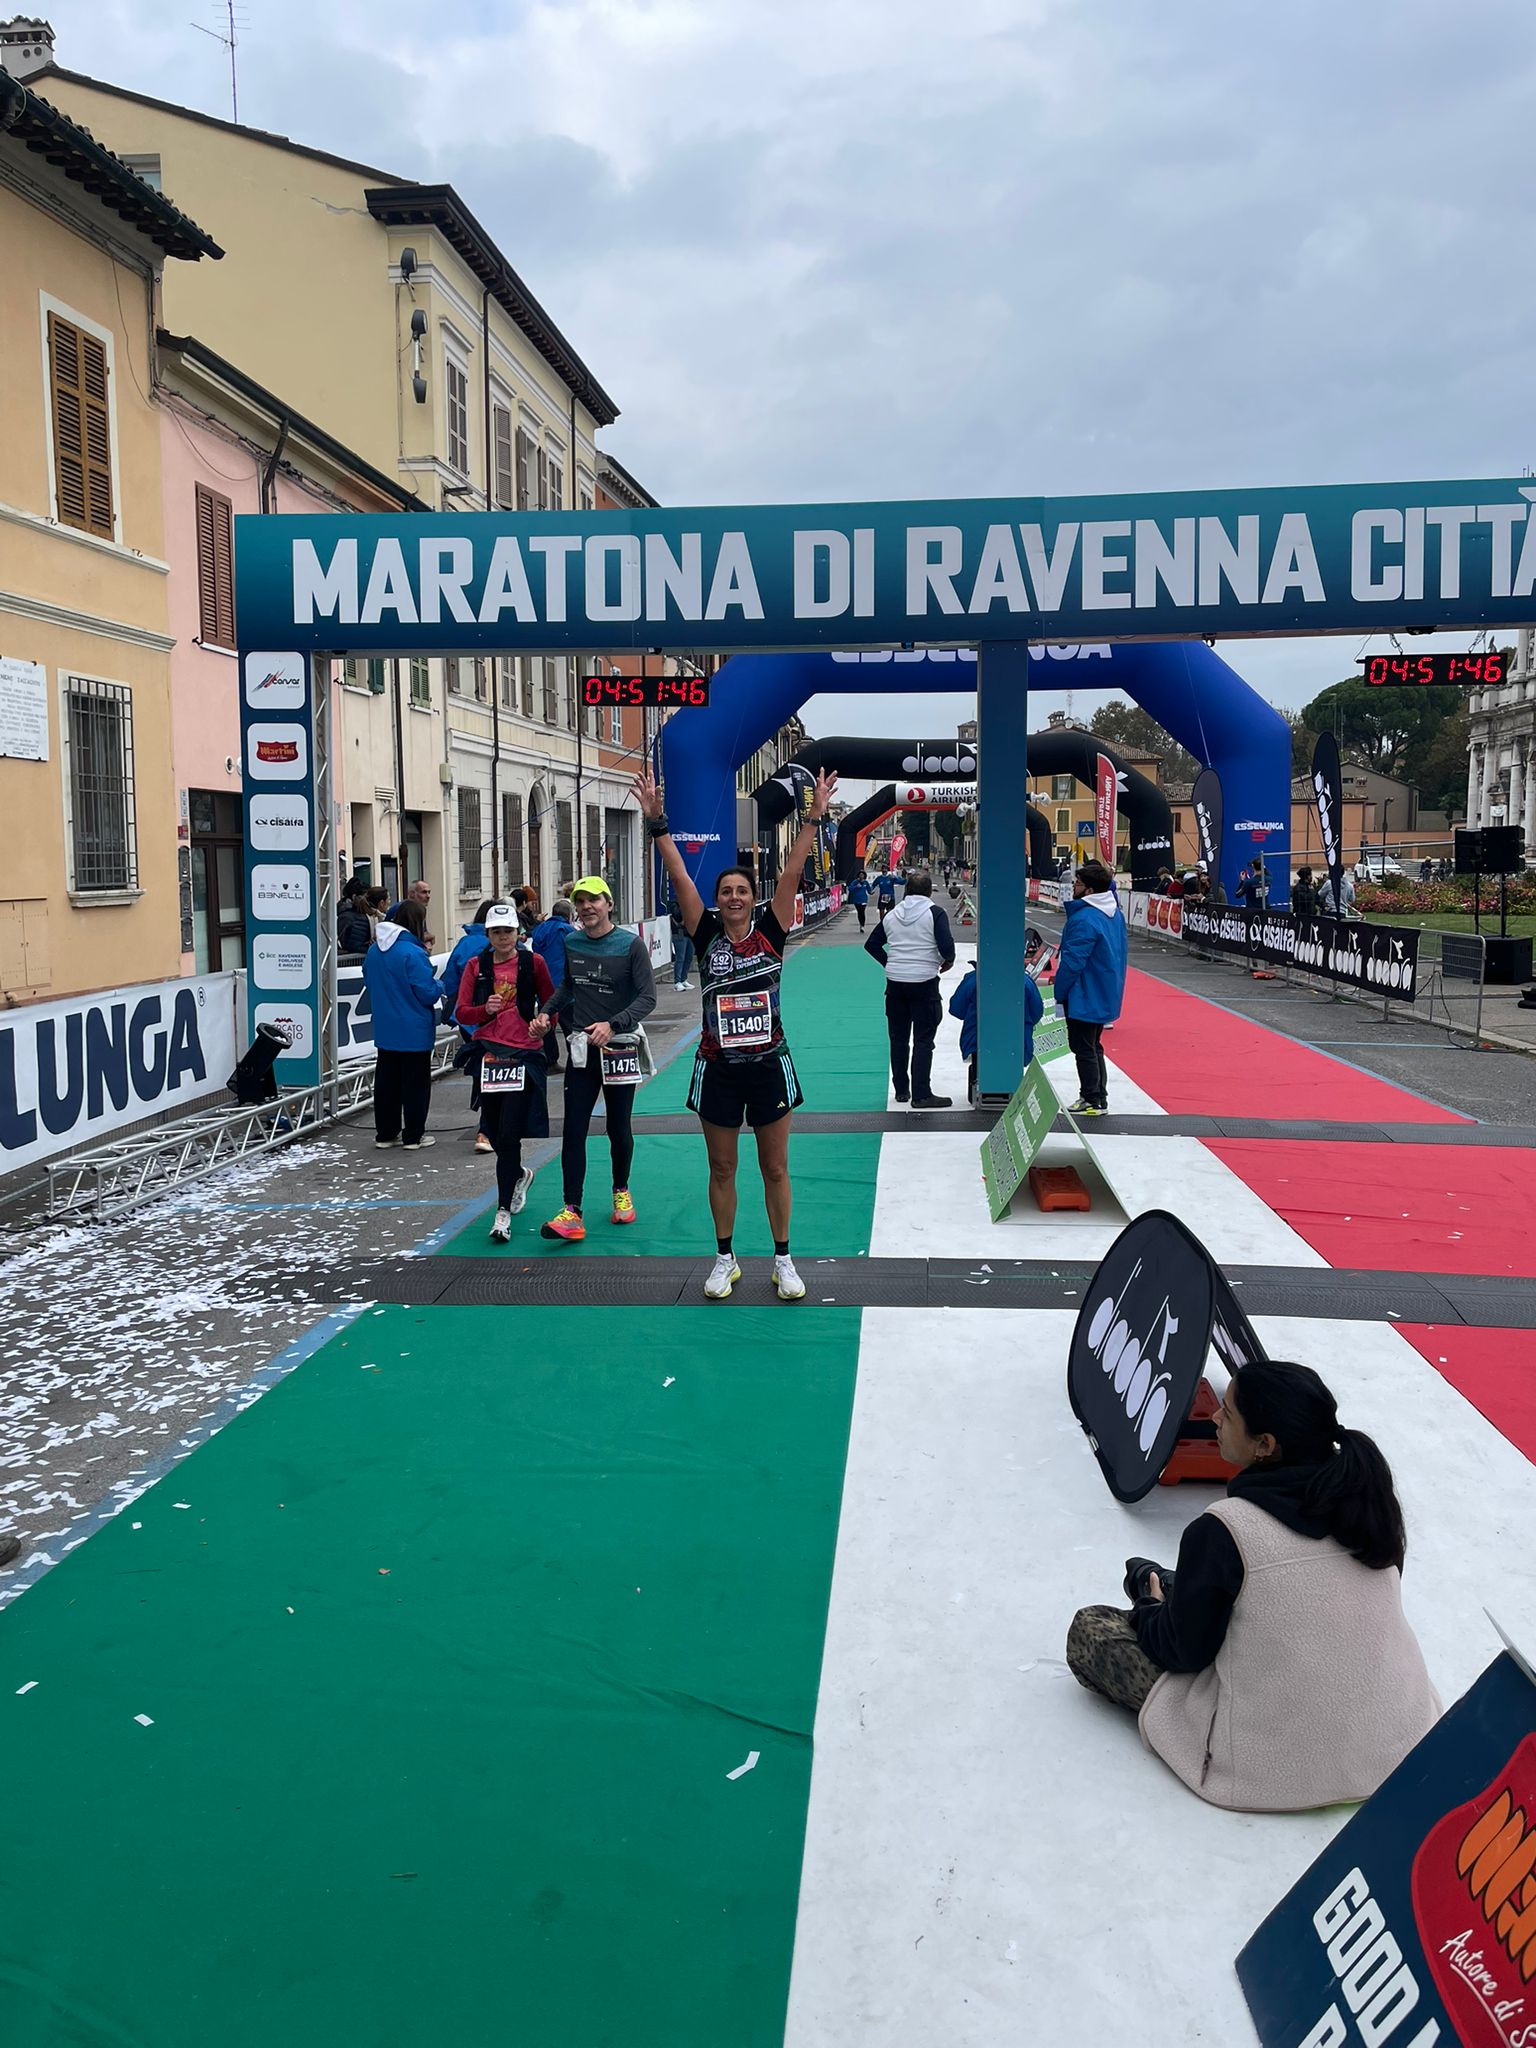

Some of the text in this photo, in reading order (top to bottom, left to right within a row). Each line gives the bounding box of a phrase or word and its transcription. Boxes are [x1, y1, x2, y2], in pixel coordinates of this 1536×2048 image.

[293, 532, 764, 624] MARATONA
[794, 529, 874, 619] DI
[906, 516, 1327, 616] RAVENNA
[931, 787, 978, 796] TURKISH
[269, 816, 304, 826] cisalfa
[1234, 821, 1285, 831] ESSELUNGA
[671, 833, 721, 842] ESSELUNGA
[1219, 919, 1247, 943] cisalfa
[1262, 924, 1296, 953] cisalfa
[730, 1016, 763, 1034] 1540
[490, 1068, 517, 1082] 1474
[610, 1058, 636, 1074] 1475
[1087, 1256, 1173, 1462] diadora
[1313, 1866, 1420, 2048] GOOD
[1439, 1928, 1536, 2048] Autore di S
